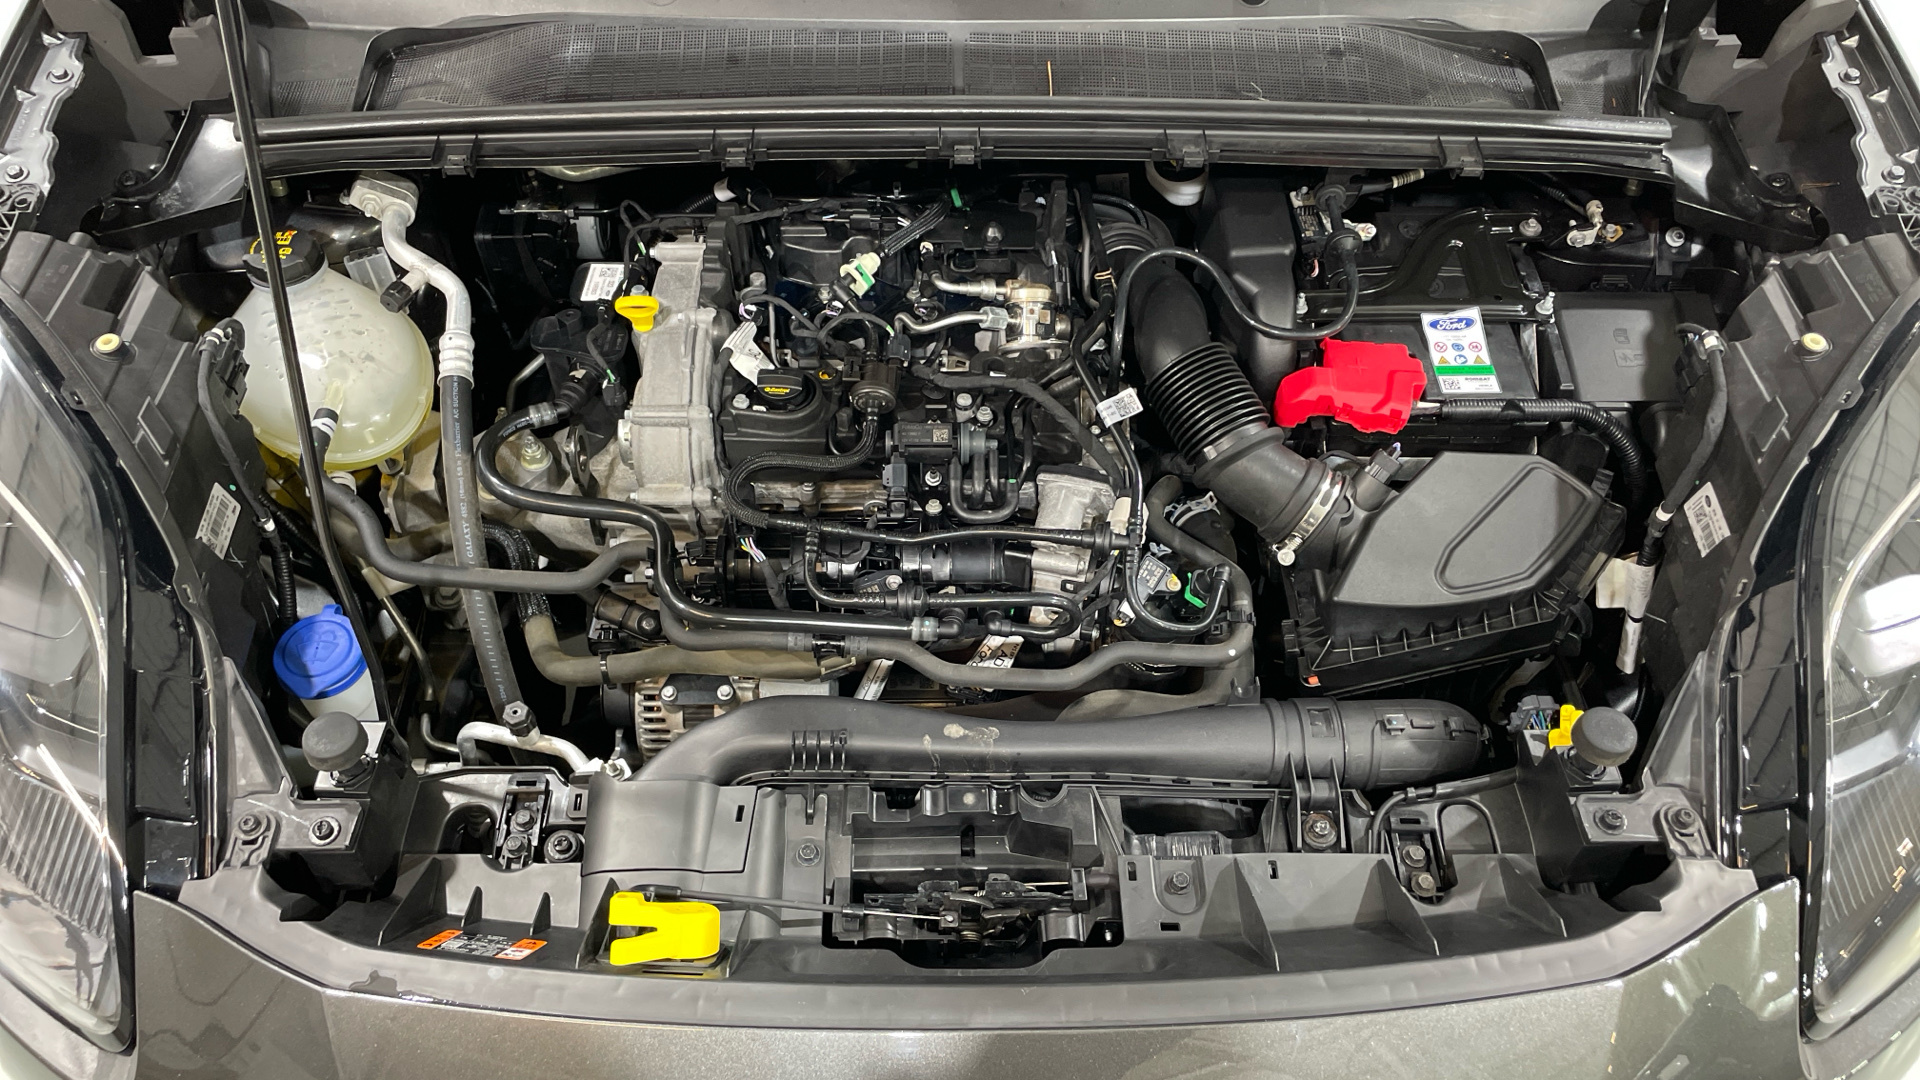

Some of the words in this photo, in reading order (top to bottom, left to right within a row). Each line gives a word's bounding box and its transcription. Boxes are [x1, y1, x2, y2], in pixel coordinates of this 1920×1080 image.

[1437, 319, 1467, 331] Ford
[454, 422, 462, 457] Flexbarrier
[462, 520, 474, 558] GALAXY
